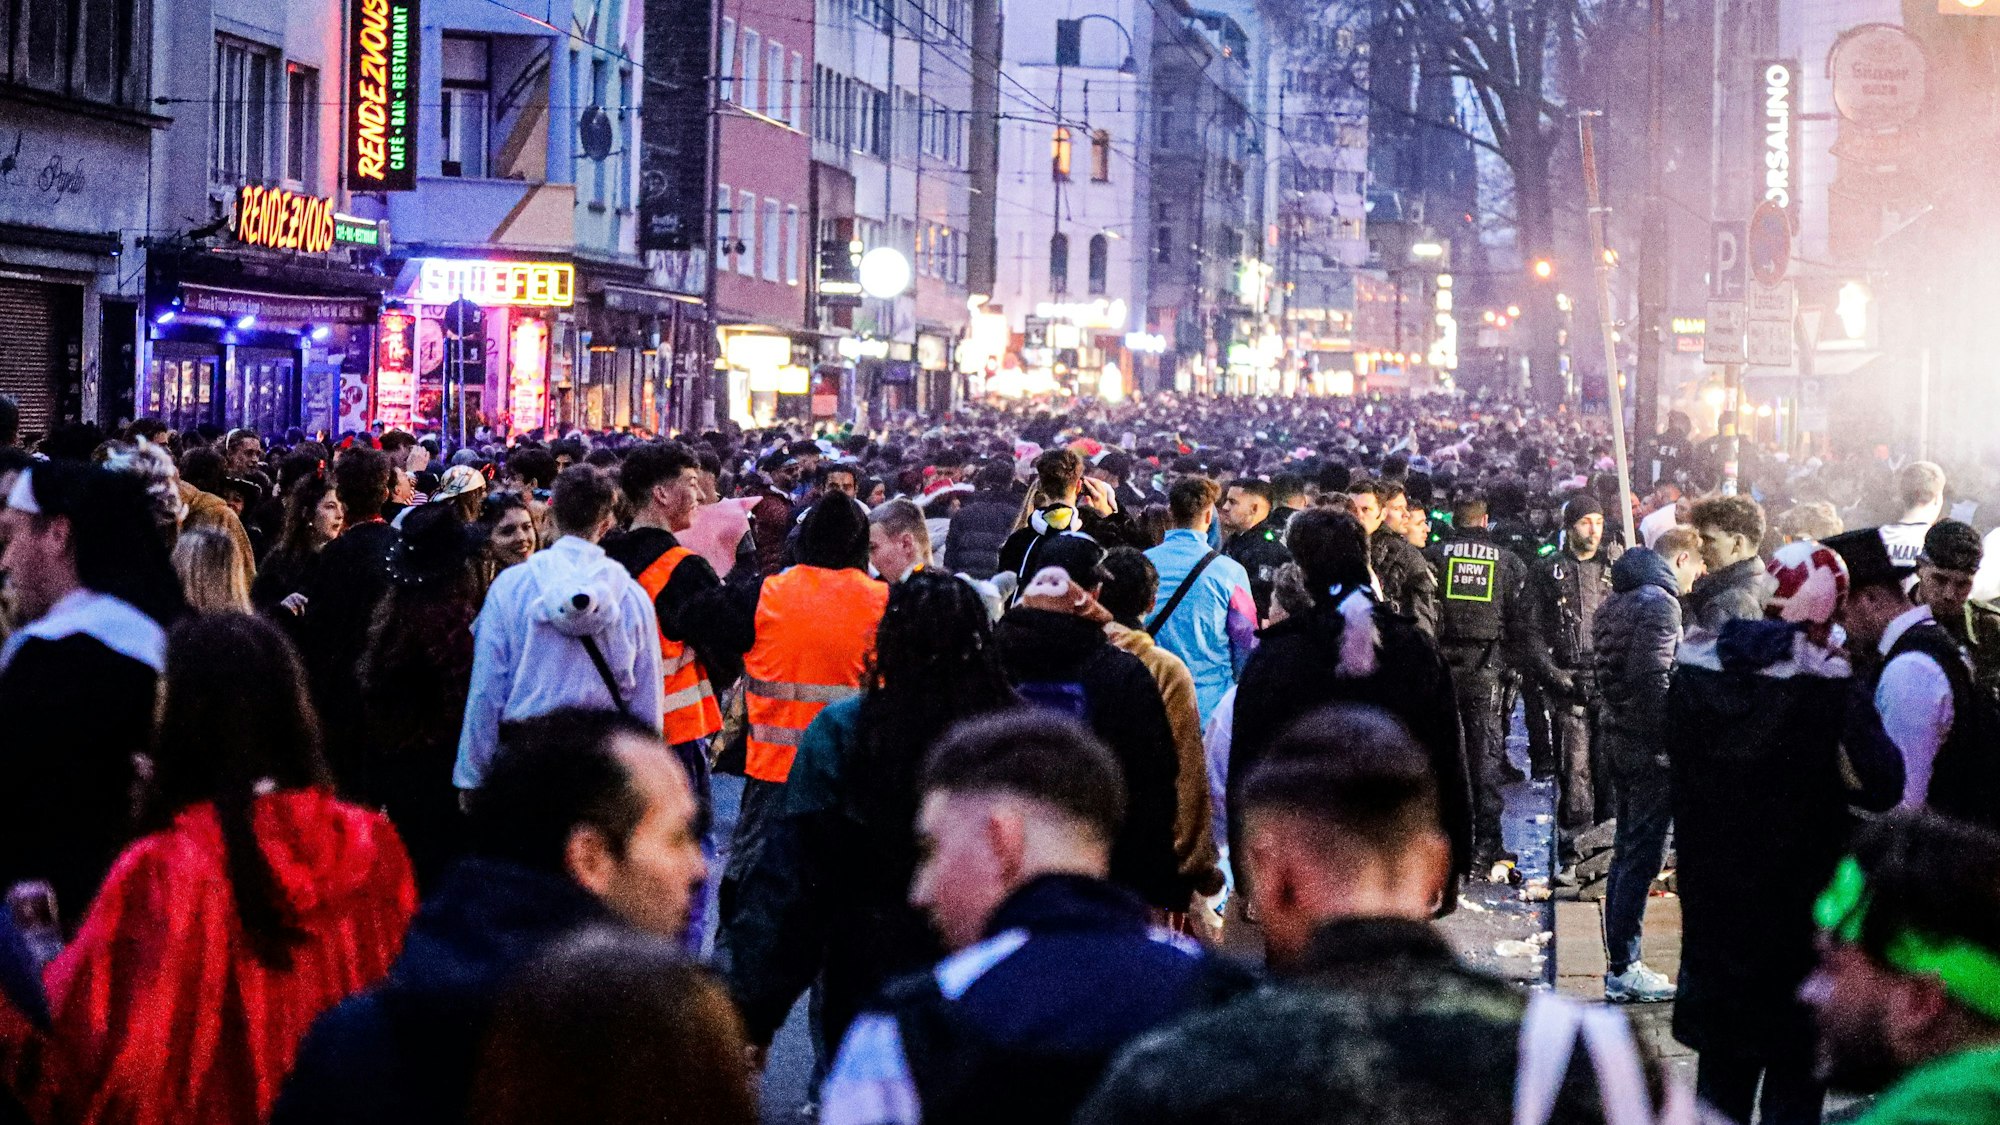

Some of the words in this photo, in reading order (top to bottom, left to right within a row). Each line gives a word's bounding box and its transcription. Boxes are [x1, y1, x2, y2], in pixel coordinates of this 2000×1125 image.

[391, 5, 409, 91] RESTAURANT
[357, 0, 390, 181] RENDEZVOUS
[391, 99, 407, 127] BAR
[1765, 64, 1790, 209] ORSALINO
[389, 137, 406, 170] CAFÉ
[238, 184, 335, 254] RENDEZVOUS
[1443, 542, 1500, 561] POLIZEI
[1453, 574, 1460, 583] 3
[1461, 575, 1474, 585] BF
[1475, 576, 1487, 586] 13
[1458, 563, 1485, 575] NRW
